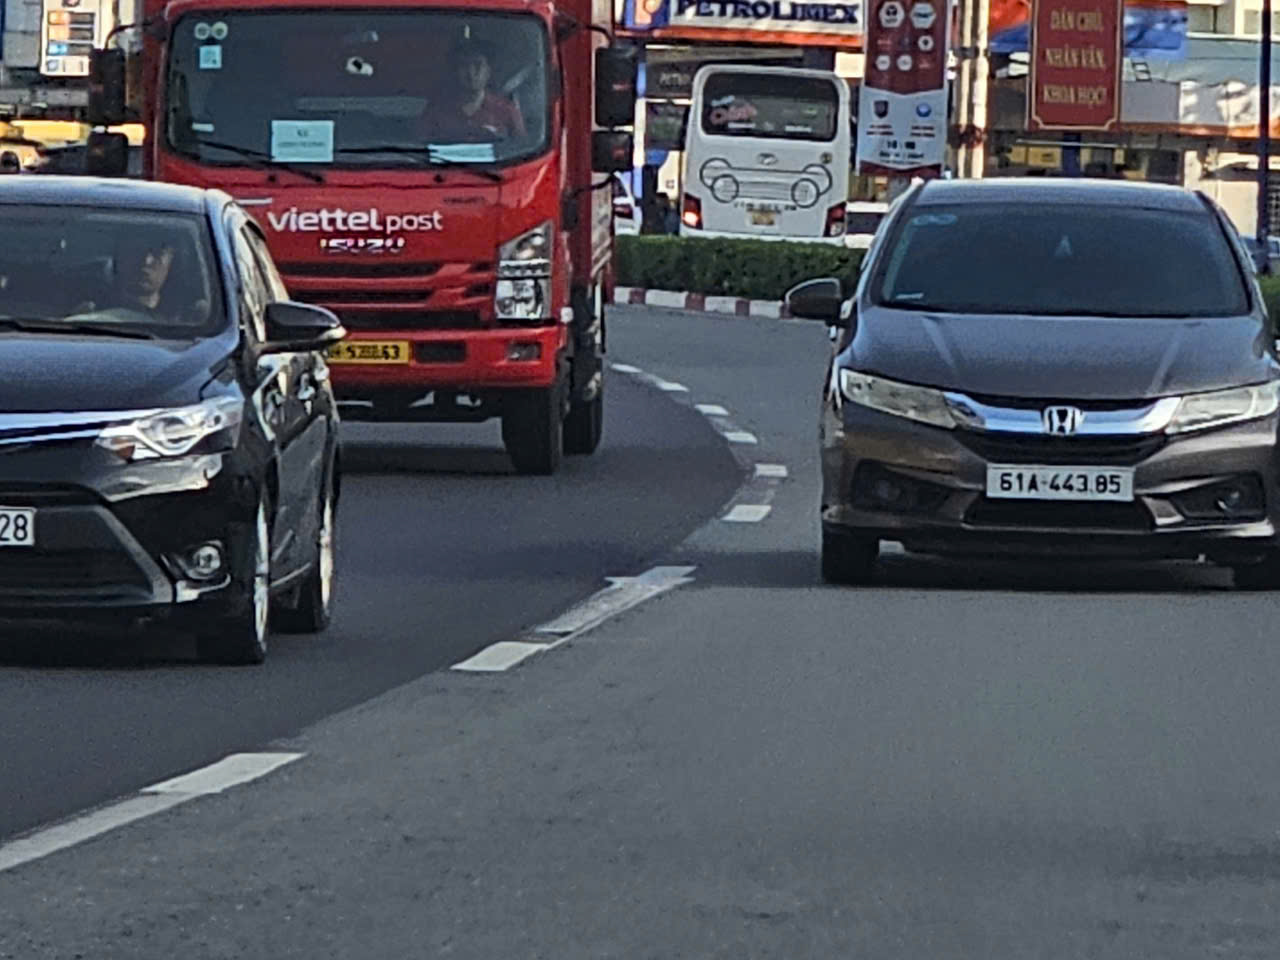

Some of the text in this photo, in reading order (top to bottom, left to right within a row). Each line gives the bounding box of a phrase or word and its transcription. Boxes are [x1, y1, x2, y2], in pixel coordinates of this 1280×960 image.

[267, 207, 443, 235] viettel post
[0, 514, 28, 541] 28
